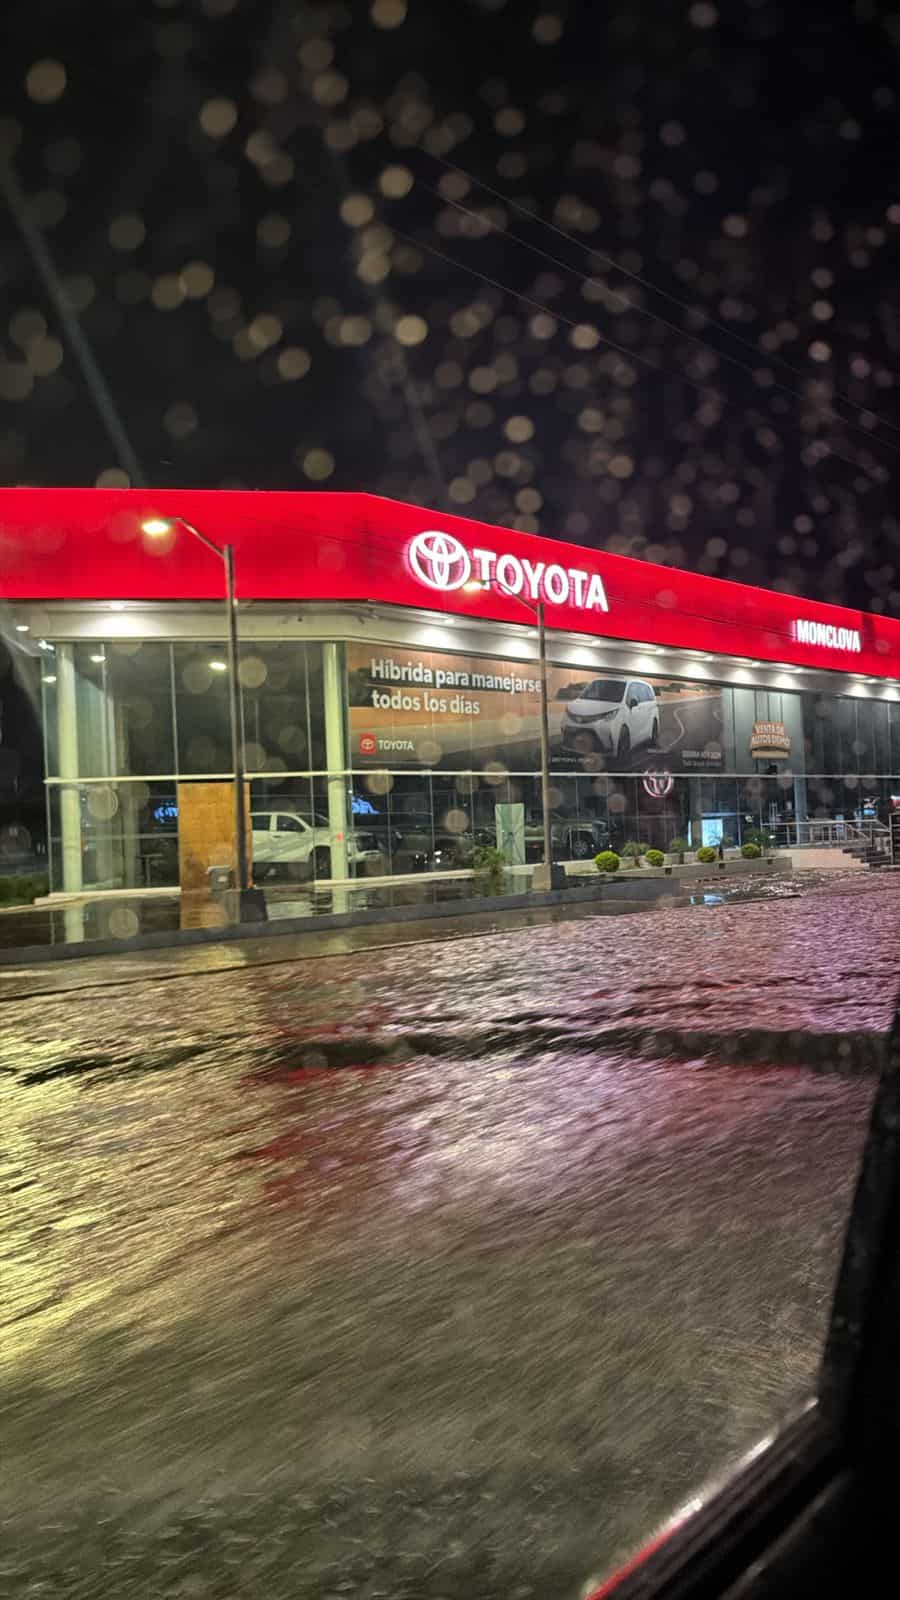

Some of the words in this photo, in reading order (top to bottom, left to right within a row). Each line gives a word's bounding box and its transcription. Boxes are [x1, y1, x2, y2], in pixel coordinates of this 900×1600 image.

[471, 548, 609, 613] TOYOTA
[796, 619, 861, 653] MONCLOVA
[370, 658, 433, 684] Híbrida
[435, 669, 470, 689] para
[472, 673, 542, 695] manejarse
[371, 689, 421, 712] todos
[424, 692, 447, 713] los
[449, 694, 480, 715] días
[378, 739, 414, 751] TOYOTA
